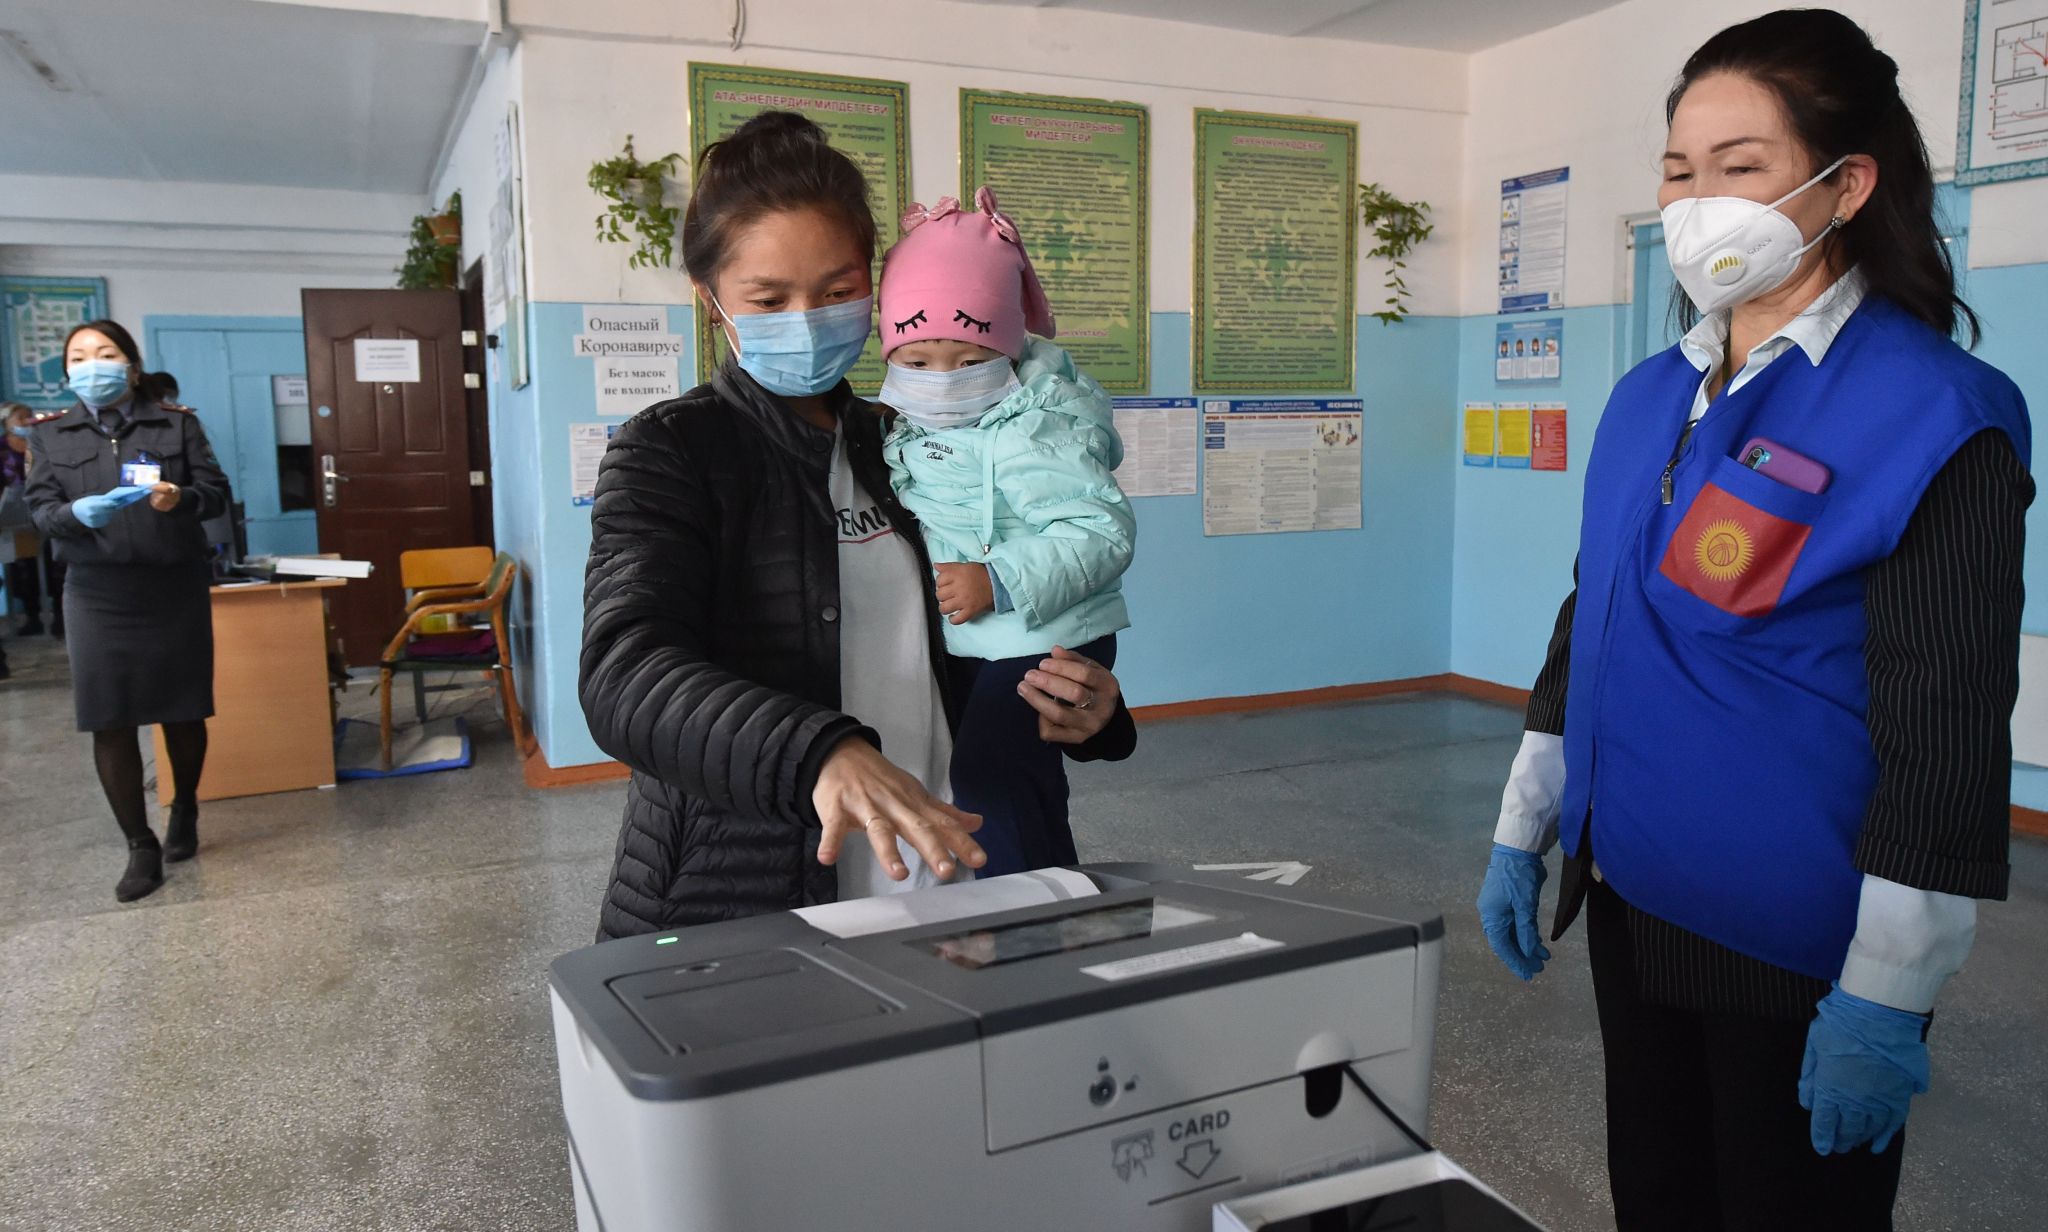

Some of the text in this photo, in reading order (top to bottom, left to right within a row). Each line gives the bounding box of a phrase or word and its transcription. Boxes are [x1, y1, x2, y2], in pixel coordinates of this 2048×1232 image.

[589, 317, 660, 332] Опасный
[580, 338, 680, 356] Коронавирус
[608, 368, 667, 378] Без масок
[604, 385, 672, 395] не входить!
[1168, 1109, 1230, 1141] CARD
